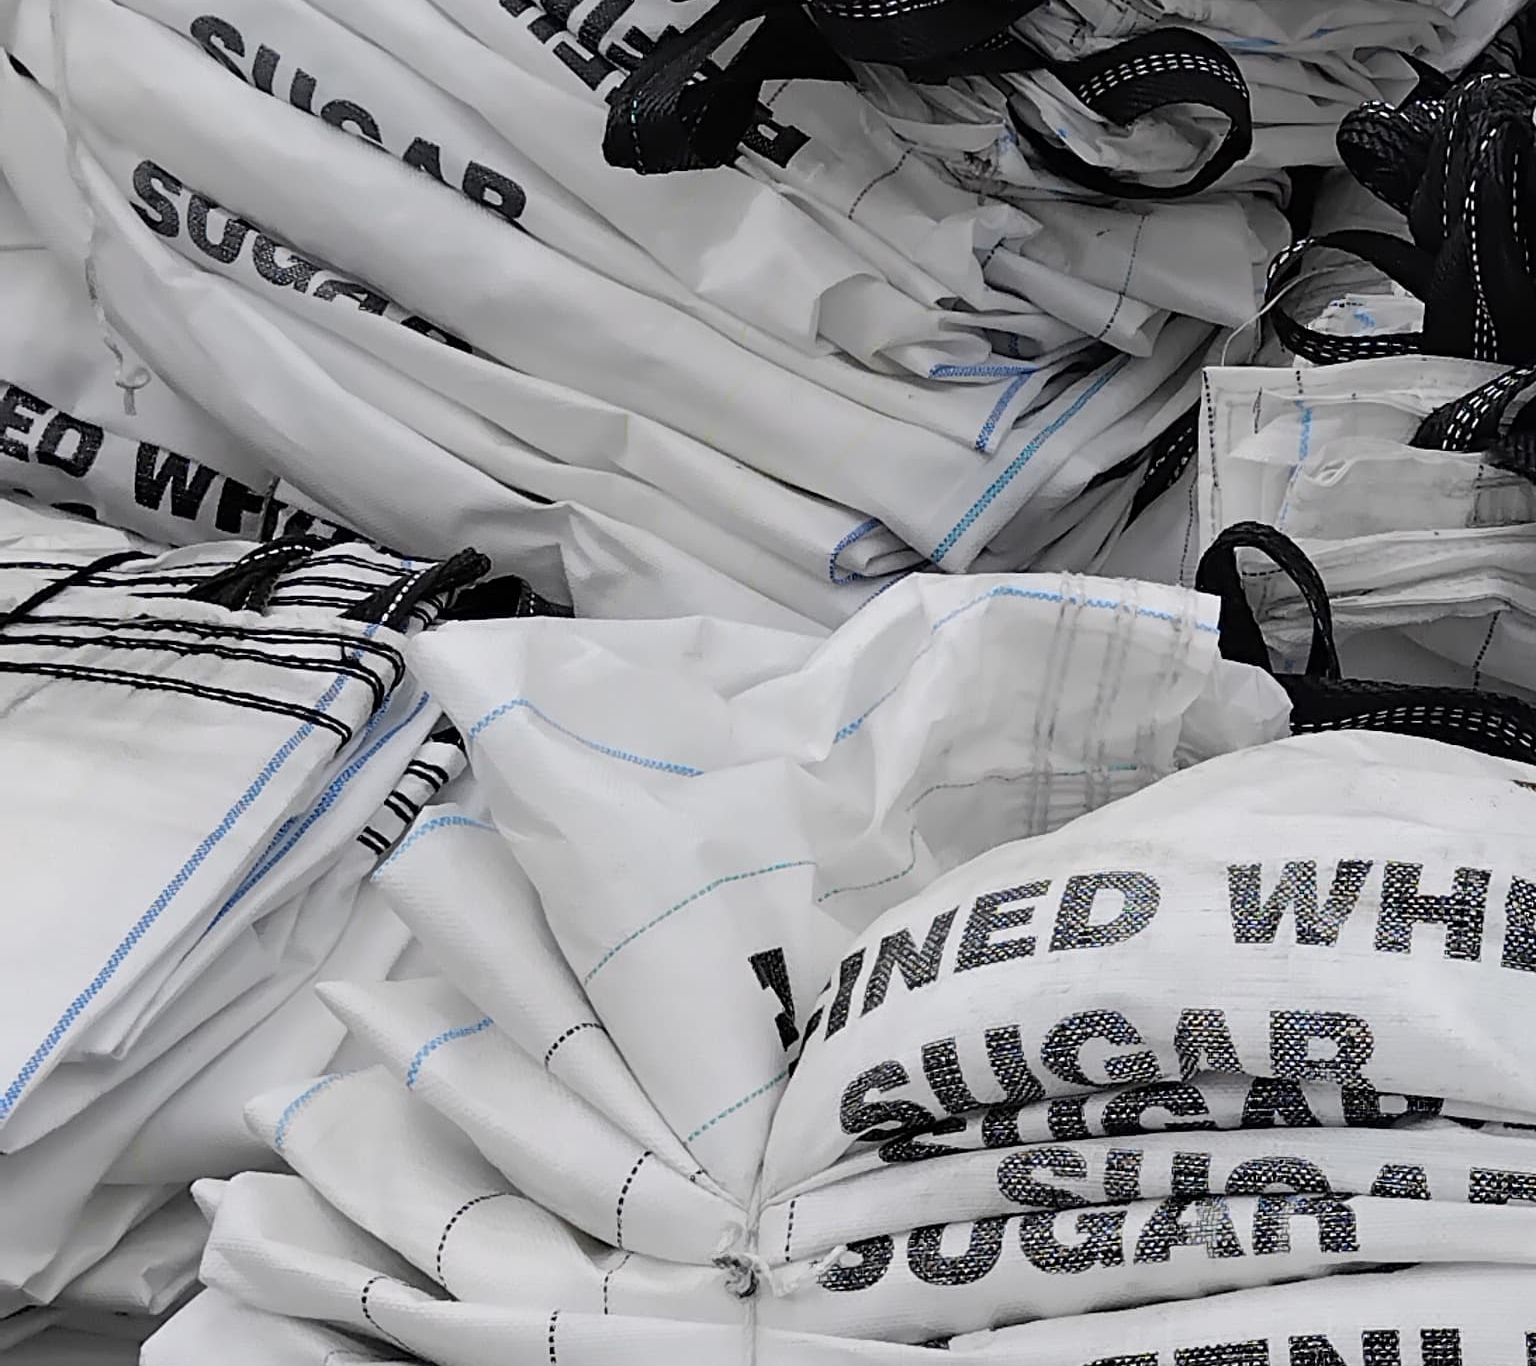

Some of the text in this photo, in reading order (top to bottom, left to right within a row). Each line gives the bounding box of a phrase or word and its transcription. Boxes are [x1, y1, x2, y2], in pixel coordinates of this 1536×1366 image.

[130, 159, 473, 354] SUGA
[748, 871, 1161, 1077] INED
[840, 1008, 1374, 1140] SUGAR
